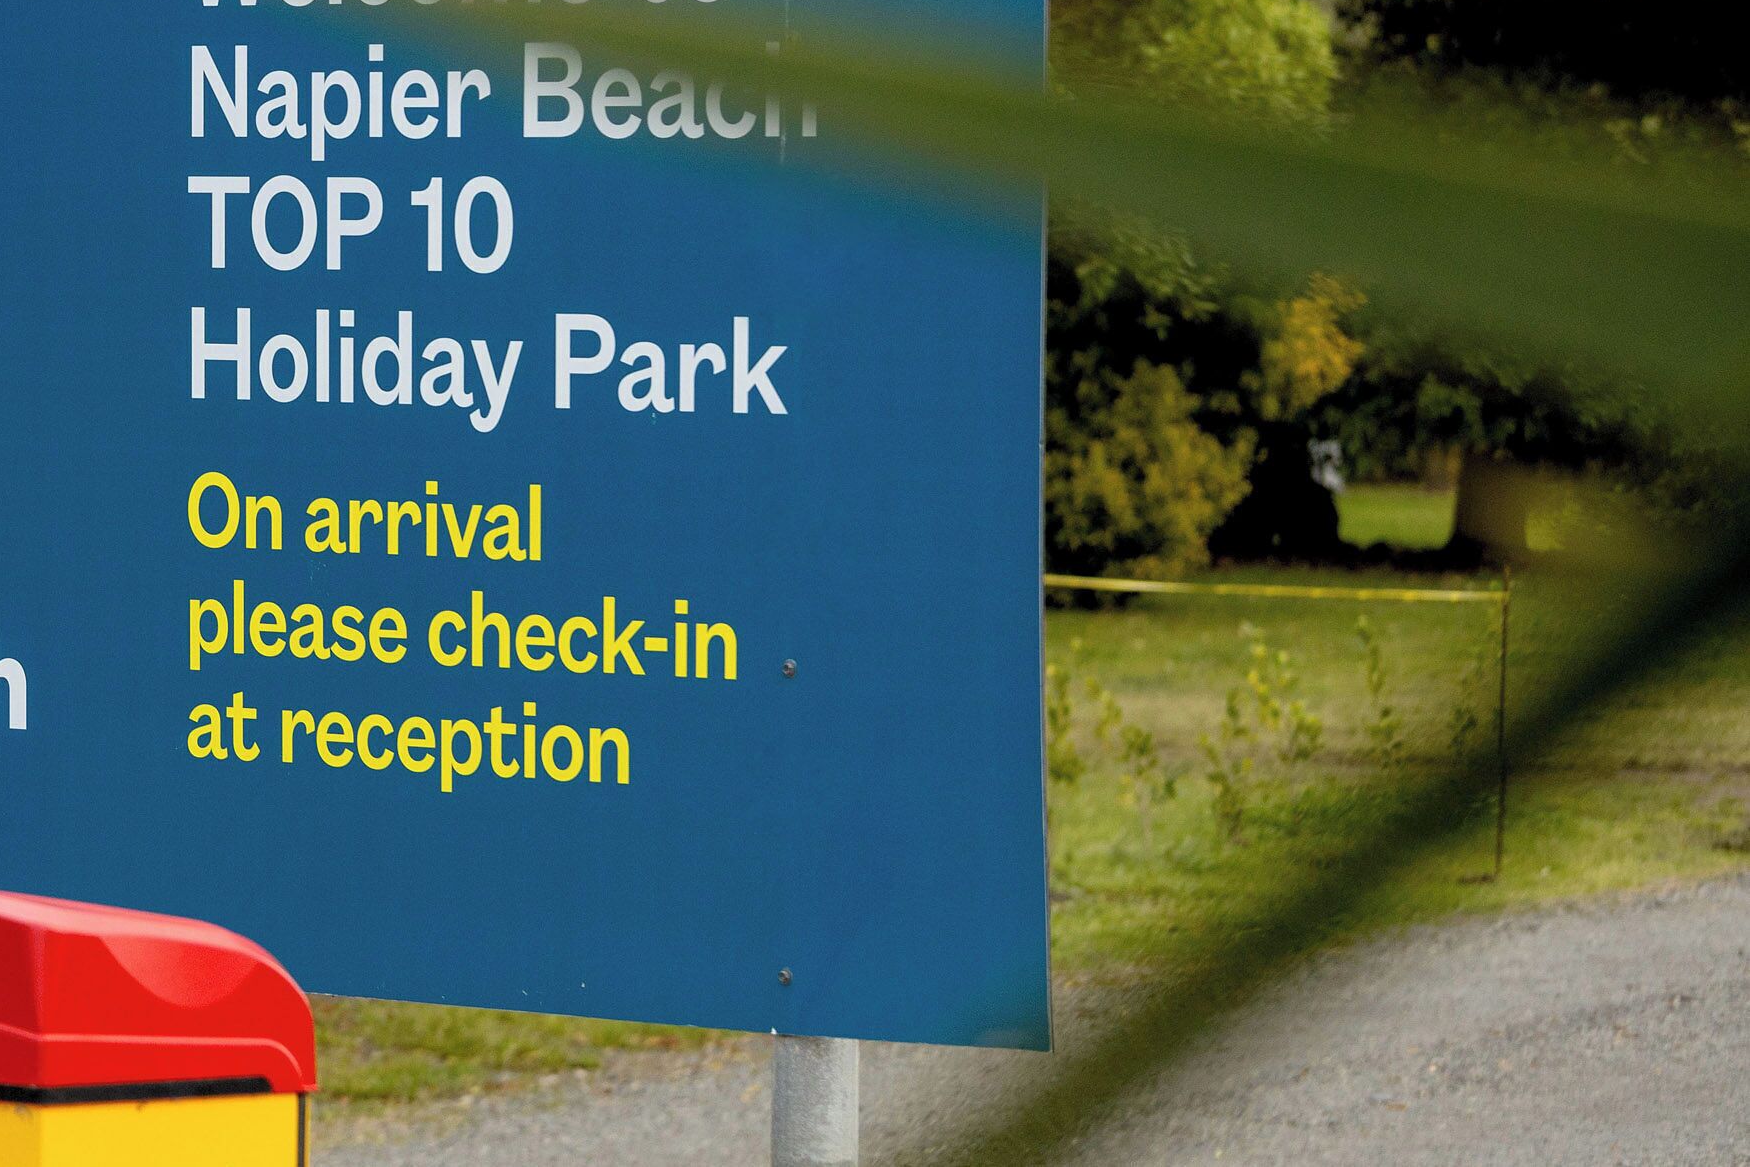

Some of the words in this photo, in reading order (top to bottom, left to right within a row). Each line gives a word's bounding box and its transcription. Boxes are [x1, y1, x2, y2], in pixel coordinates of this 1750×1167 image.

[191, 44, 491, 161] Napier
[188, 175, 383, 272] TOP
[411, 176, 514, 274] 10
[191, 307, 523, 432] Holiday
[554, 314, 788, 414] Park
[188, 472, 283, 550] On
[305, 481, 542, 561] arrival
[189, 580, 407, 670] please
[428, 591, 737, 680] check-in
[187, 692, 260, 761] at
[281, 702, 630, 792] reception
